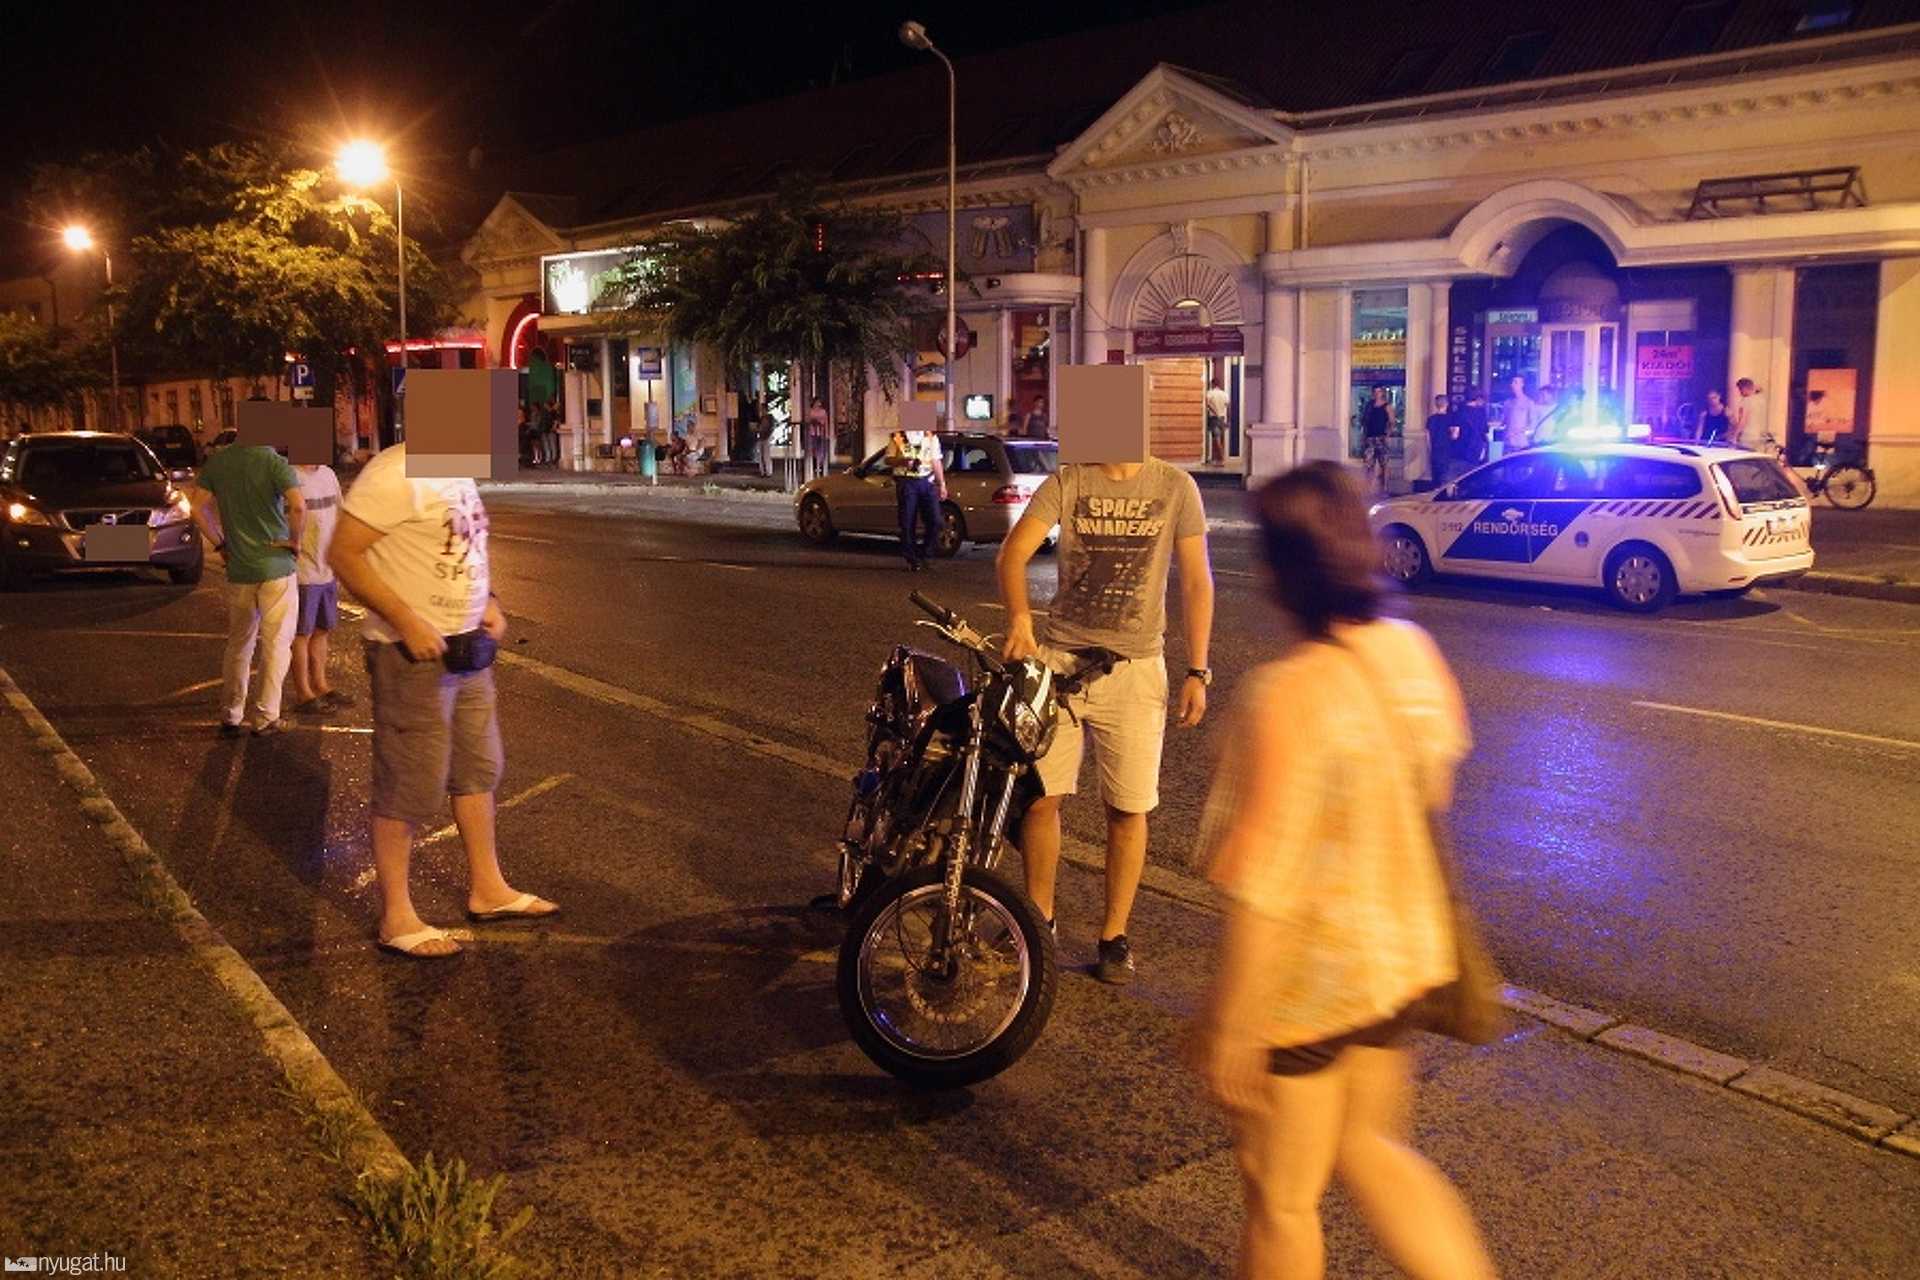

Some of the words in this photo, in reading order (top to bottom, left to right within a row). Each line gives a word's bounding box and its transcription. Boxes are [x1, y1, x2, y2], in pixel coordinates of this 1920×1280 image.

[297, 364, 309, 385] P
[1087, 496, 1153, 520] SPACE
[1473, 520, 1560, 537] RENDŐRSÉG
